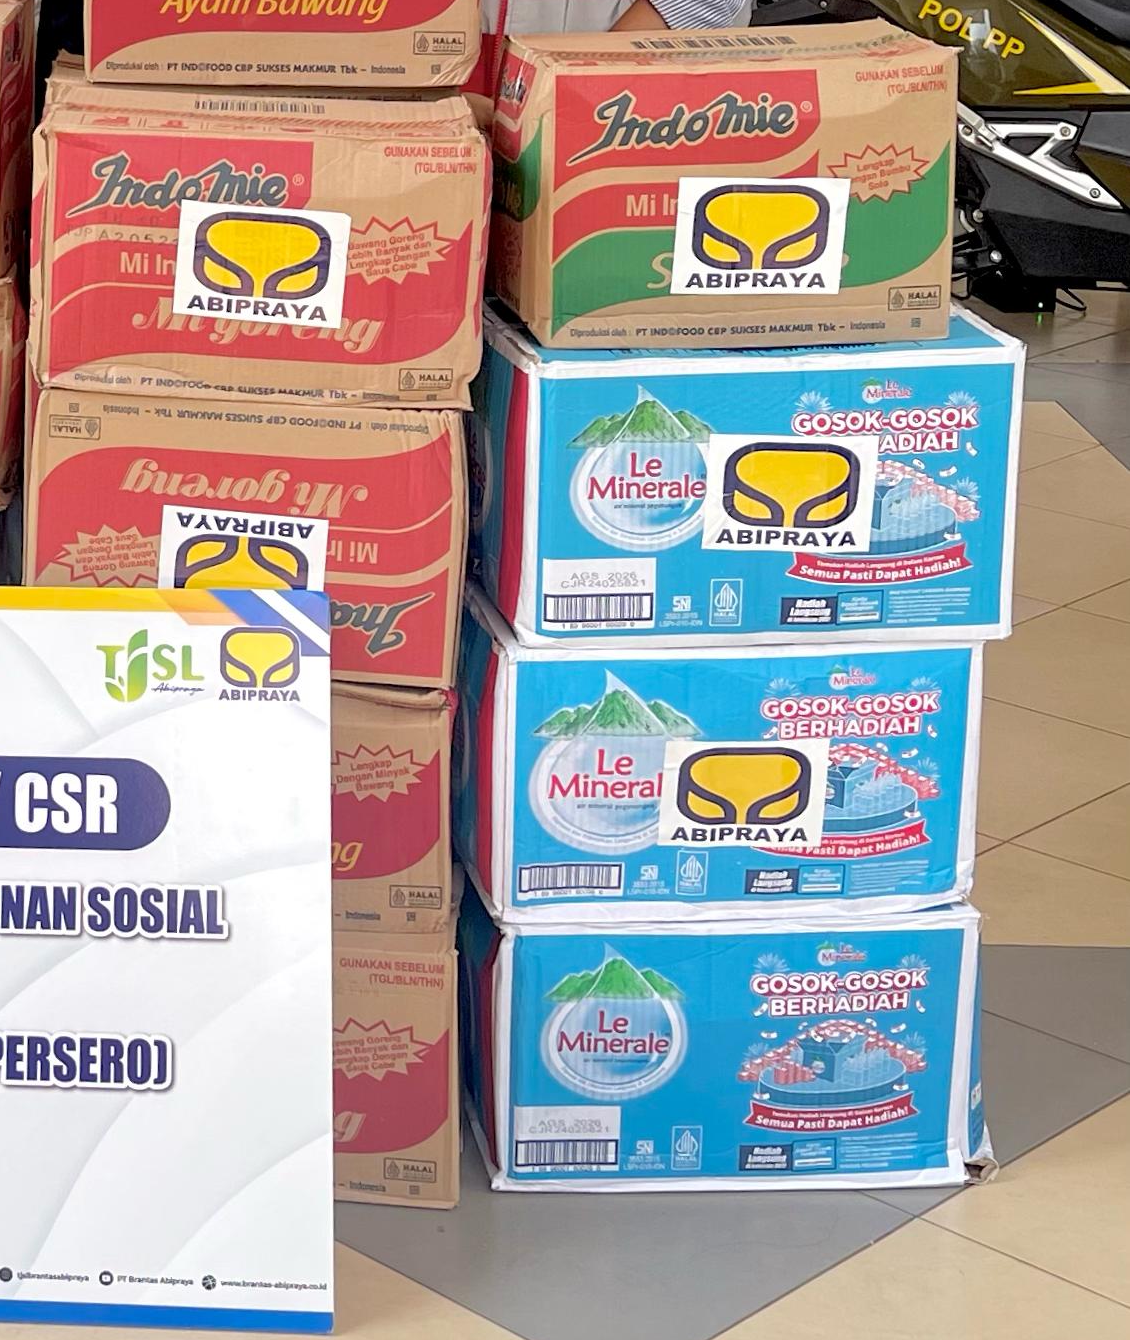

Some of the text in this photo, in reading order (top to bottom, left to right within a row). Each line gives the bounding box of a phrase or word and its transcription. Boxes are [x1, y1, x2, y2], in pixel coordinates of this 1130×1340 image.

[982, 27, 1025, 59] PP
[167, 63, 177, 72] PT
[626, 194, 654, 217] Mi
[120, 253, 149, 275] Mi
[686, 272, 825, 289] ABIPRAYA
[908, 291, 937, 300] HALAL
[187, 295, 327, 321] ABIPRAYA
[418, 373, 451, 381] HALAL
[793, 407, 978, 433] GOSOK-GOSOK
[879, 431, 958, 453] ADIAH
[630, 452, 662, 477] Le
[588, 474, 707, 499] Minerale
[176, 512, 314, 539] ABIPRAYA
[716, 528, 856, 547] ABIPRAYA
[800, 558, 961, 581] Semua Pasti Dapat Hadiah!
[219, 689, 301, 702] ABIPRAYA
[763, 693, 940, 718] GOSOK-GOSOK
[780, 716, 921, 739] BERHADIAH
[597, 749, 633, 776] Le
[548, 775, 663, 799] Mineral
[14, 772, 118, 835] CSR
[671, 826, 808, 843] ABIPRAYA
[838, 844, 874, 856] Dapat
[876, 835, 920, 852] Hadiah!
[408, 891, 440, 899] HALAL
[87, 887, 226, 934] SOSIAL
[339, 958, 445, 974] GUNAKAN SEBELUM
[752, 969, 926, 995] GOSOK-GOSOK
[770, 992, 908, 1016] BERHADIAH
[598, 1010, 630, 1034] Le
[557, 1029, 670, 1055] Minerale
[755, 1115, 795, 1129] Semua
[797, 1119, 825, 1129] Pasti
[828, 1118, 862, 1129] Dapat
[865, 1107, 908, 1124] Hadiah!
[402, 1163, 434, 1172] HALAL
[129, 1276, 194, 1286] Brantas Abipraya
